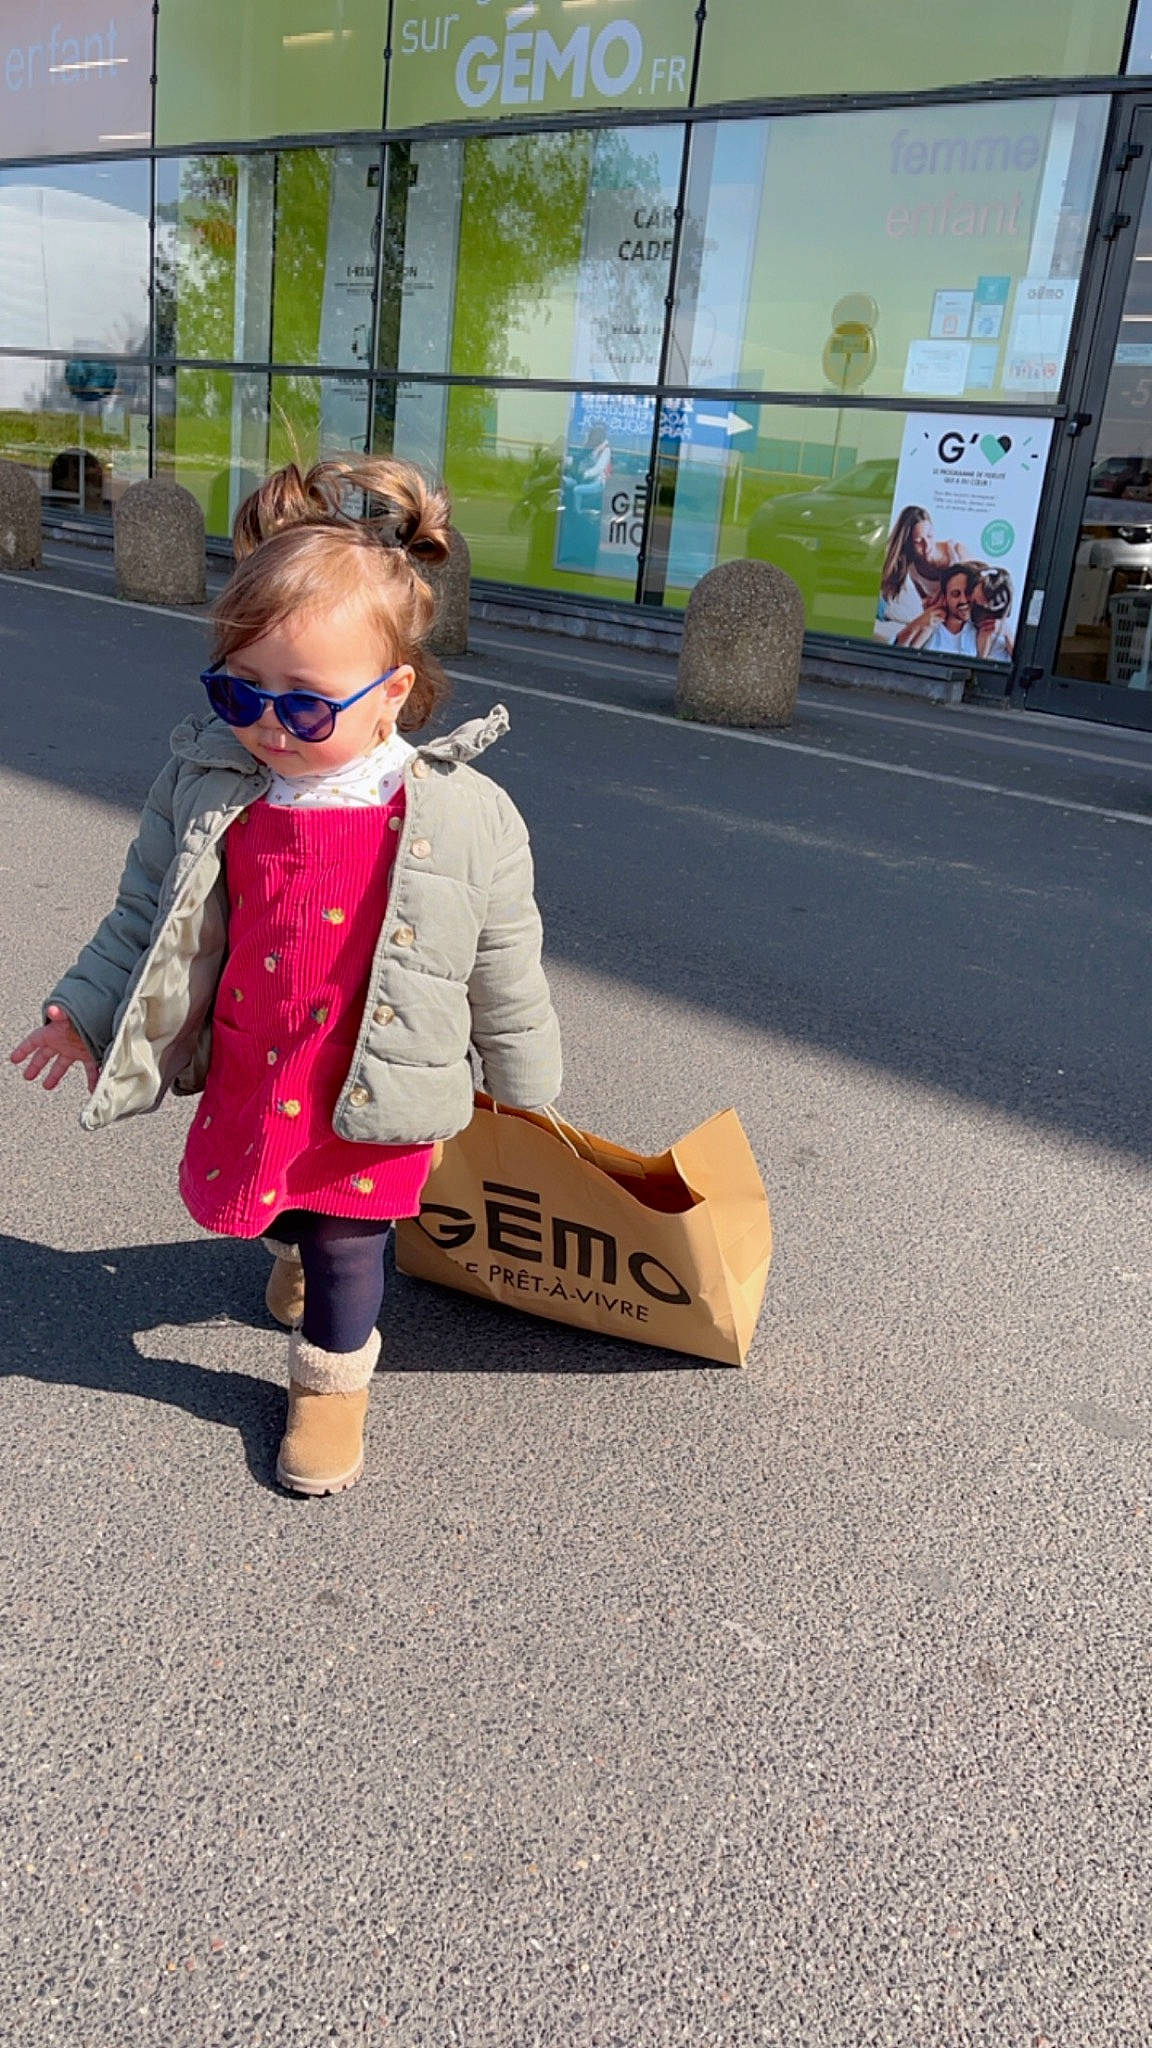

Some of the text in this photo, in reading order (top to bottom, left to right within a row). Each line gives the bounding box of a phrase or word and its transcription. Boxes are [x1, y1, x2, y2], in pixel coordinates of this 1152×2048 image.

[5, 17, 119, 94] enfant
[402, 14, 460, 53] sur
[890, 129, 1041, 176] femme
[886, 190, 1023, 240] enfant
[488, 1264, 650, 1323] PRÊT-À-VIVRE
